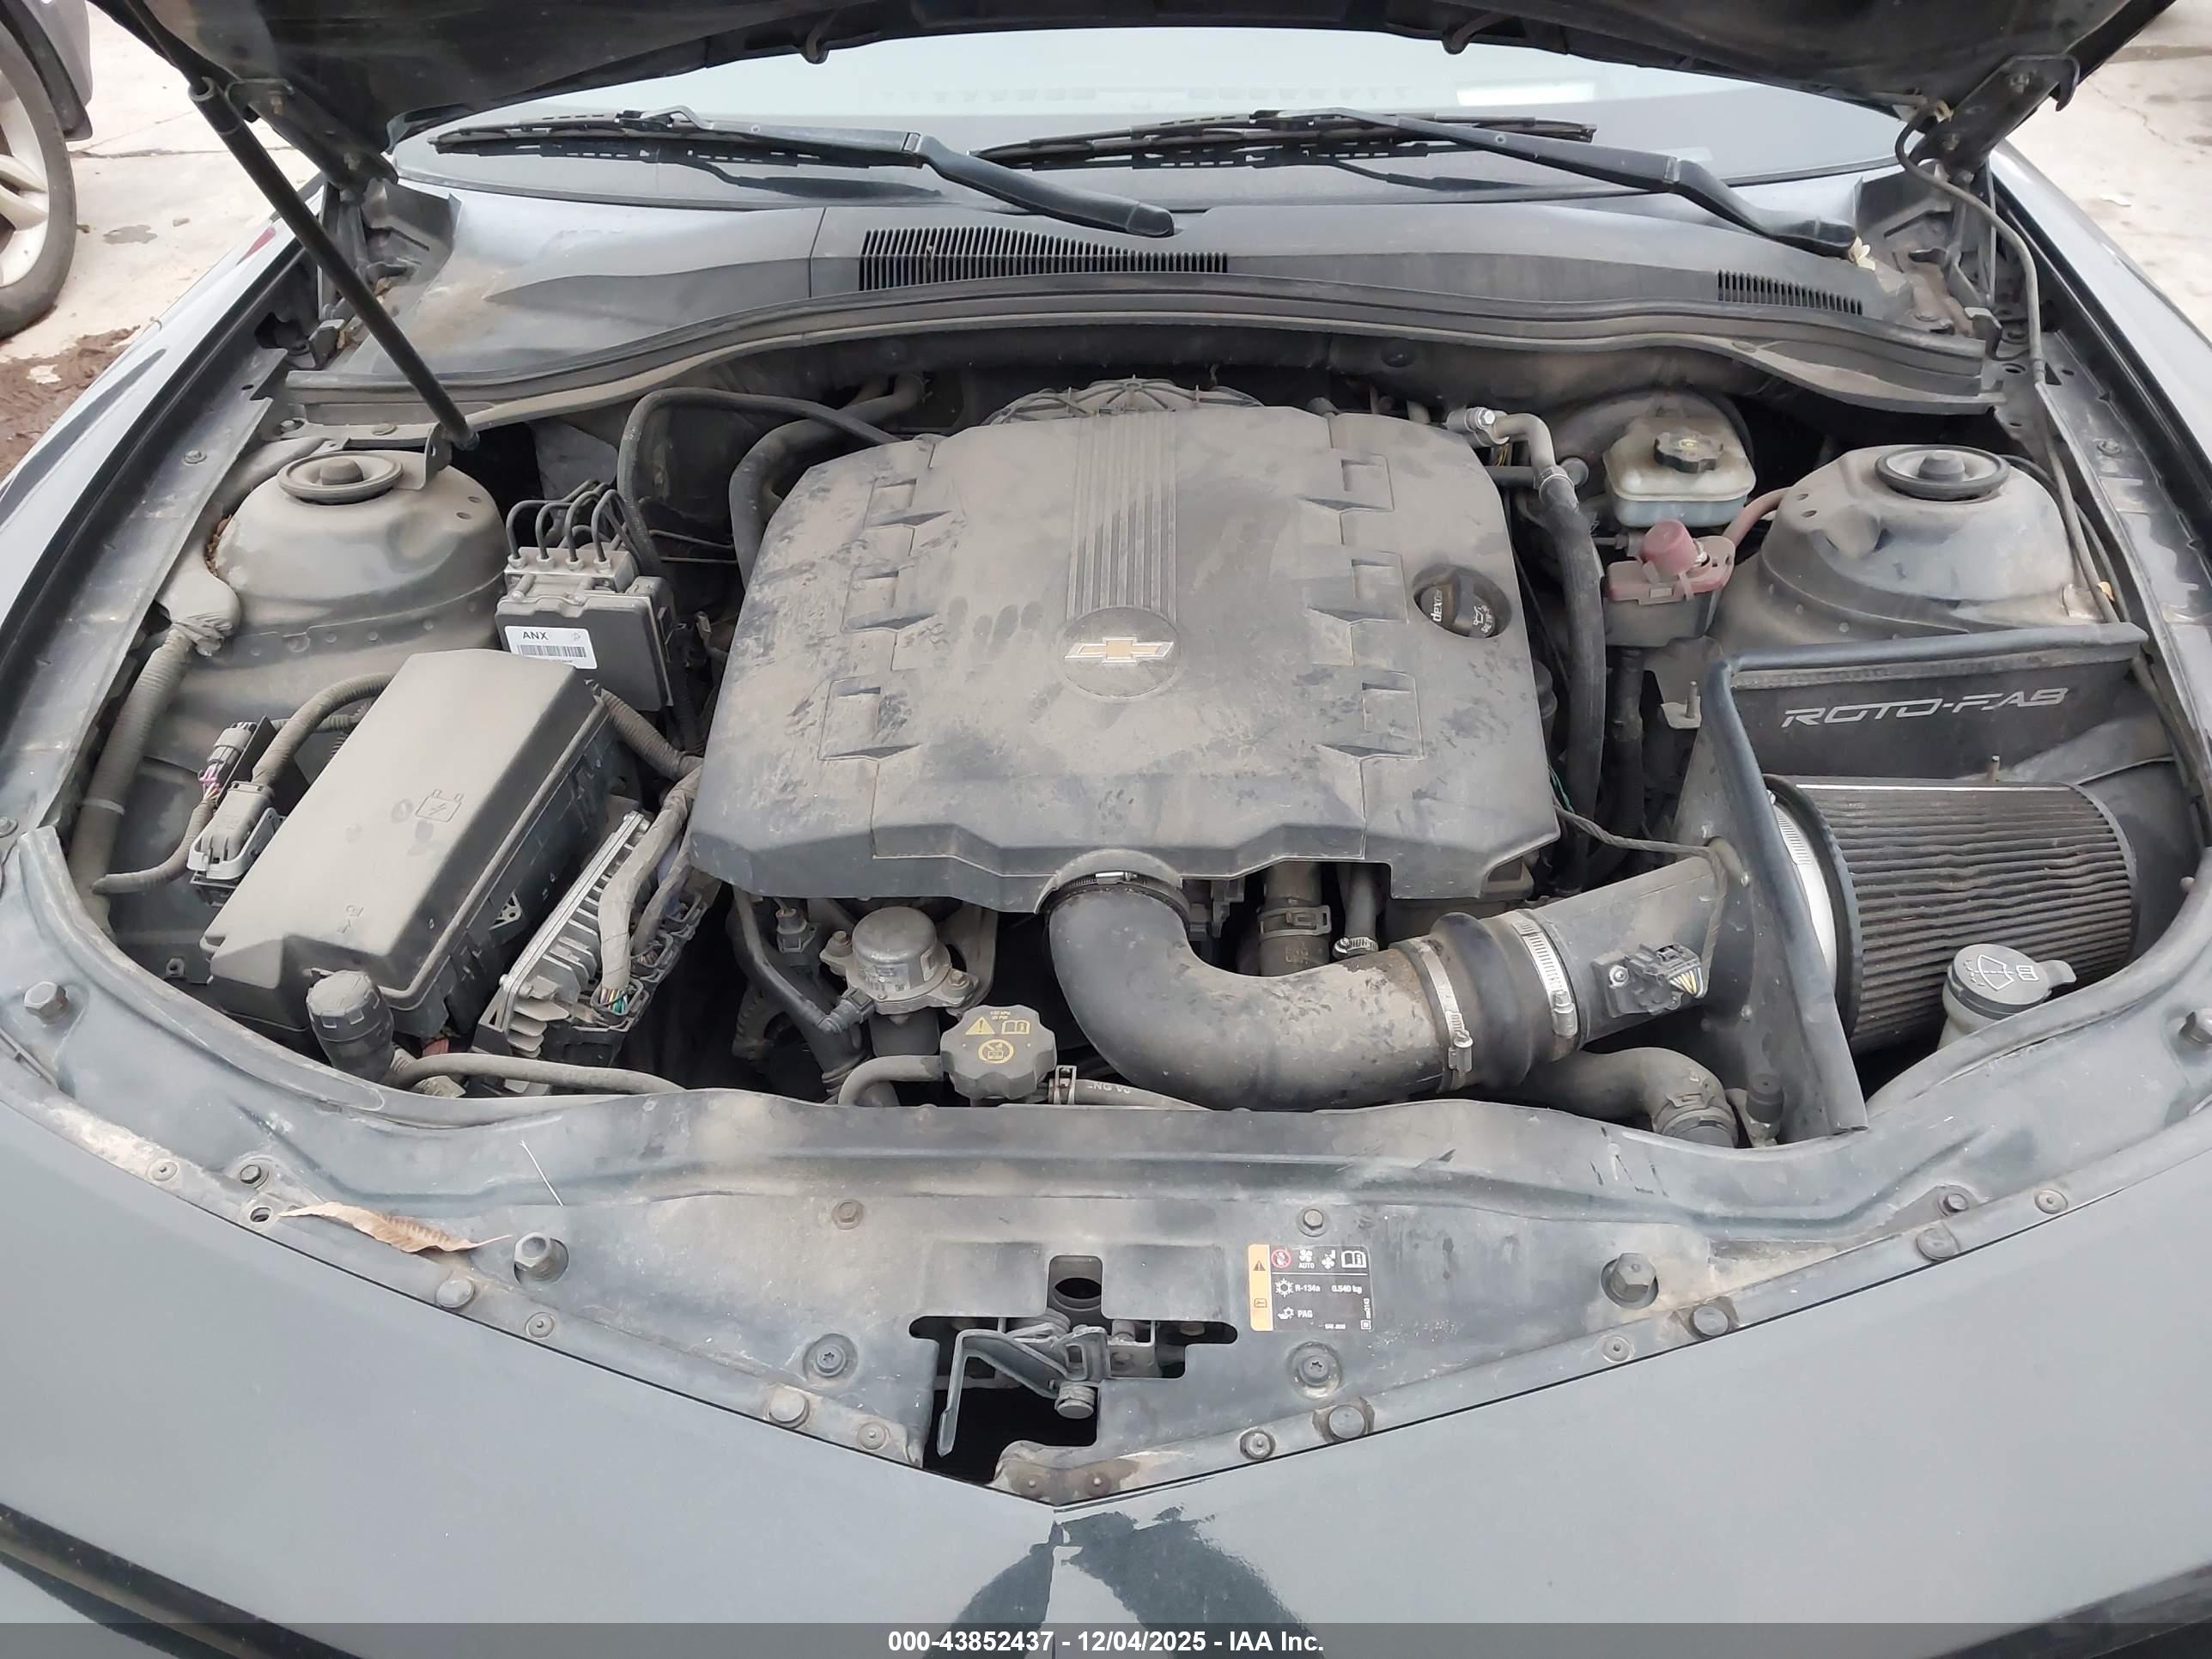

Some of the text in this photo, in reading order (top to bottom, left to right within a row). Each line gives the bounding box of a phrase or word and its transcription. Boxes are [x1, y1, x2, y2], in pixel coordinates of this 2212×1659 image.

[523, 631, 549, 641] ANX
[1781, 688, 2068, 727] ROTO-FAB
[1295, 1284, 1321, 1292] R-134a
[1352, 1285, 1363, 1294] kg
[1297, 1310, 1313, 1318] PAG
